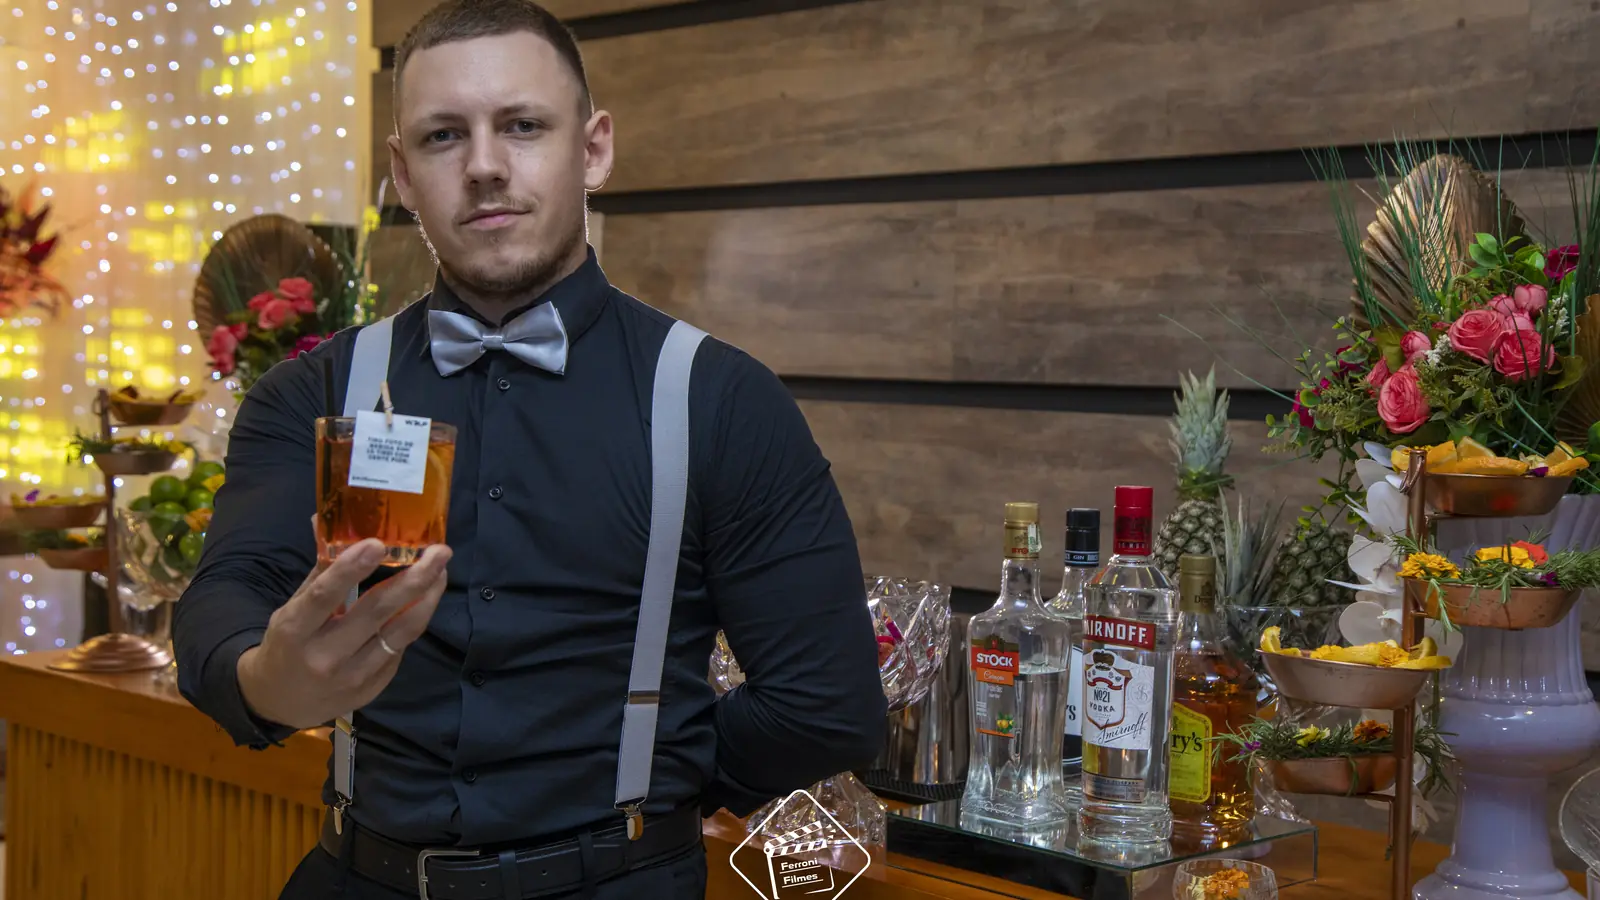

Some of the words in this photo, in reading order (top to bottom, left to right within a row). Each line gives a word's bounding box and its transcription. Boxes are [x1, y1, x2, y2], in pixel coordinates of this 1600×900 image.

[976, 653, 1013, 667] STOCK
[1089, 702, 1116, 713] VODKA
[1097, 712, 1148, 744] Smirnoff
